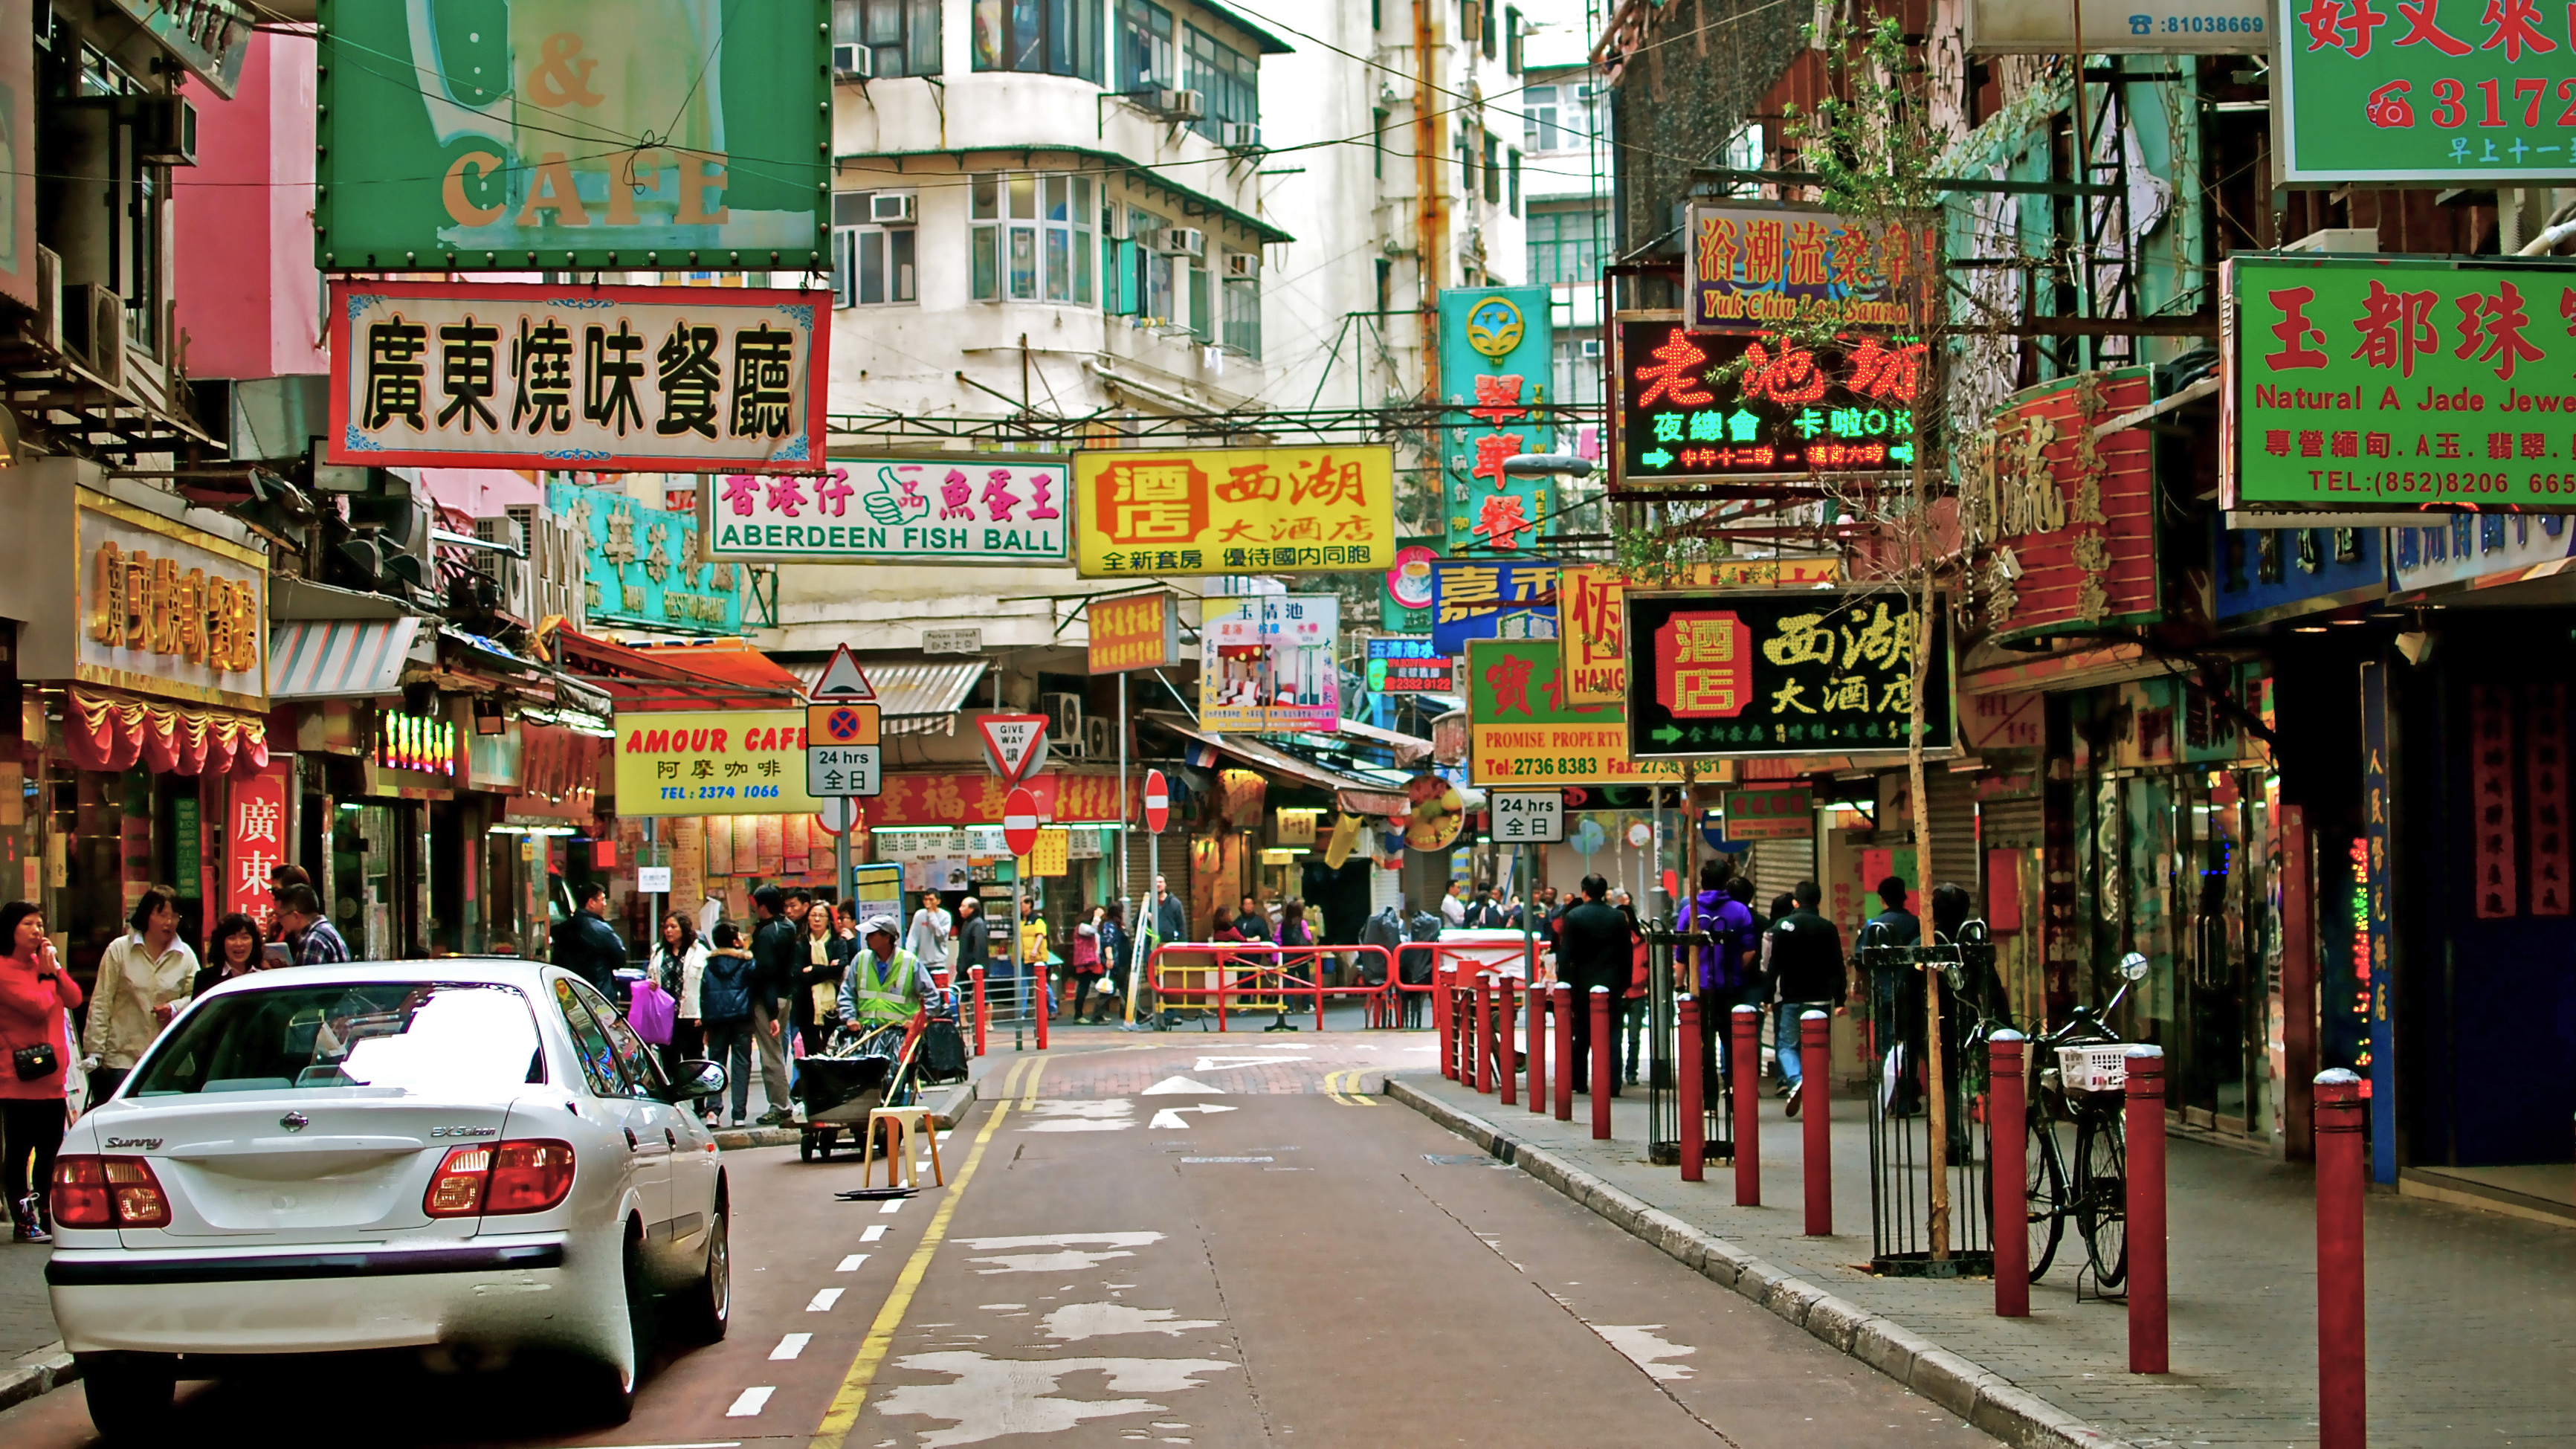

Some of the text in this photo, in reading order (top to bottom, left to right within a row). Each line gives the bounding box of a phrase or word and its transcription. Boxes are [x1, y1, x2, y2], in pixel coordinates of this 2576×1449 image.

[526, 31, 605, 108] &
[2449, 137, 2576, 164] 早上十一
[442, 151, 729, 227] CAFE
[1705, 289, 1743, 318] Yuk
[1844, 298, 1909, 325] Sauna
[2265, 280, 2576, 381] 玉都珠
[362, 312, 793, 439] 廣東燒味餐廳
[2256, 384, 2362, 411] Natural
[2379, 386, 2401, 410] A
[2418, 386, 2485, 412] Jade
[1653, 407, 1760, 442] 夜總會
[721, 468, 854, 518] 香港仔
[940, 468, 1059, 521] 魚蛋王
[1215, 455, 1366, 507] 西湖
[1113, 466, 1191, 538] 酒店
[721, 524, 1058, 551] ABERDEEN FISH BALL
[1218, 515, 1375, 543] 大酒店
[1102, 549, 1203, 571] 全新套房
[1370, 640, 1447, 659] 玉清池水
[1763, 602, 1921, 671] 西湖
[1673, 619, 1734, 711] 酒店
[1574, 668, 1624, 694] HANG
[1772, 673, 1912, 714] 大酒店
[627, 727, 807, 753] AMOUR CAFE
[1000, 725, 1024, 734] GIVE
[1001, 736, 1024, 744] WAY
[1485, 730, 1624, 749] PROMISE PROPERTY
[819, 751, 869, 764] 24 hrs
[1557, 758, 1597, 775] 8383
[699, 786, 735, 798] 2374
[743, 785, 779, 798] 1066
[824, 769, 865, 790] 全日
[1500, 798, 1554, 812] 24 hrs
[1506, 818, 1547, 836] 全日
[105, 1137, 164, 1151] Sunny
